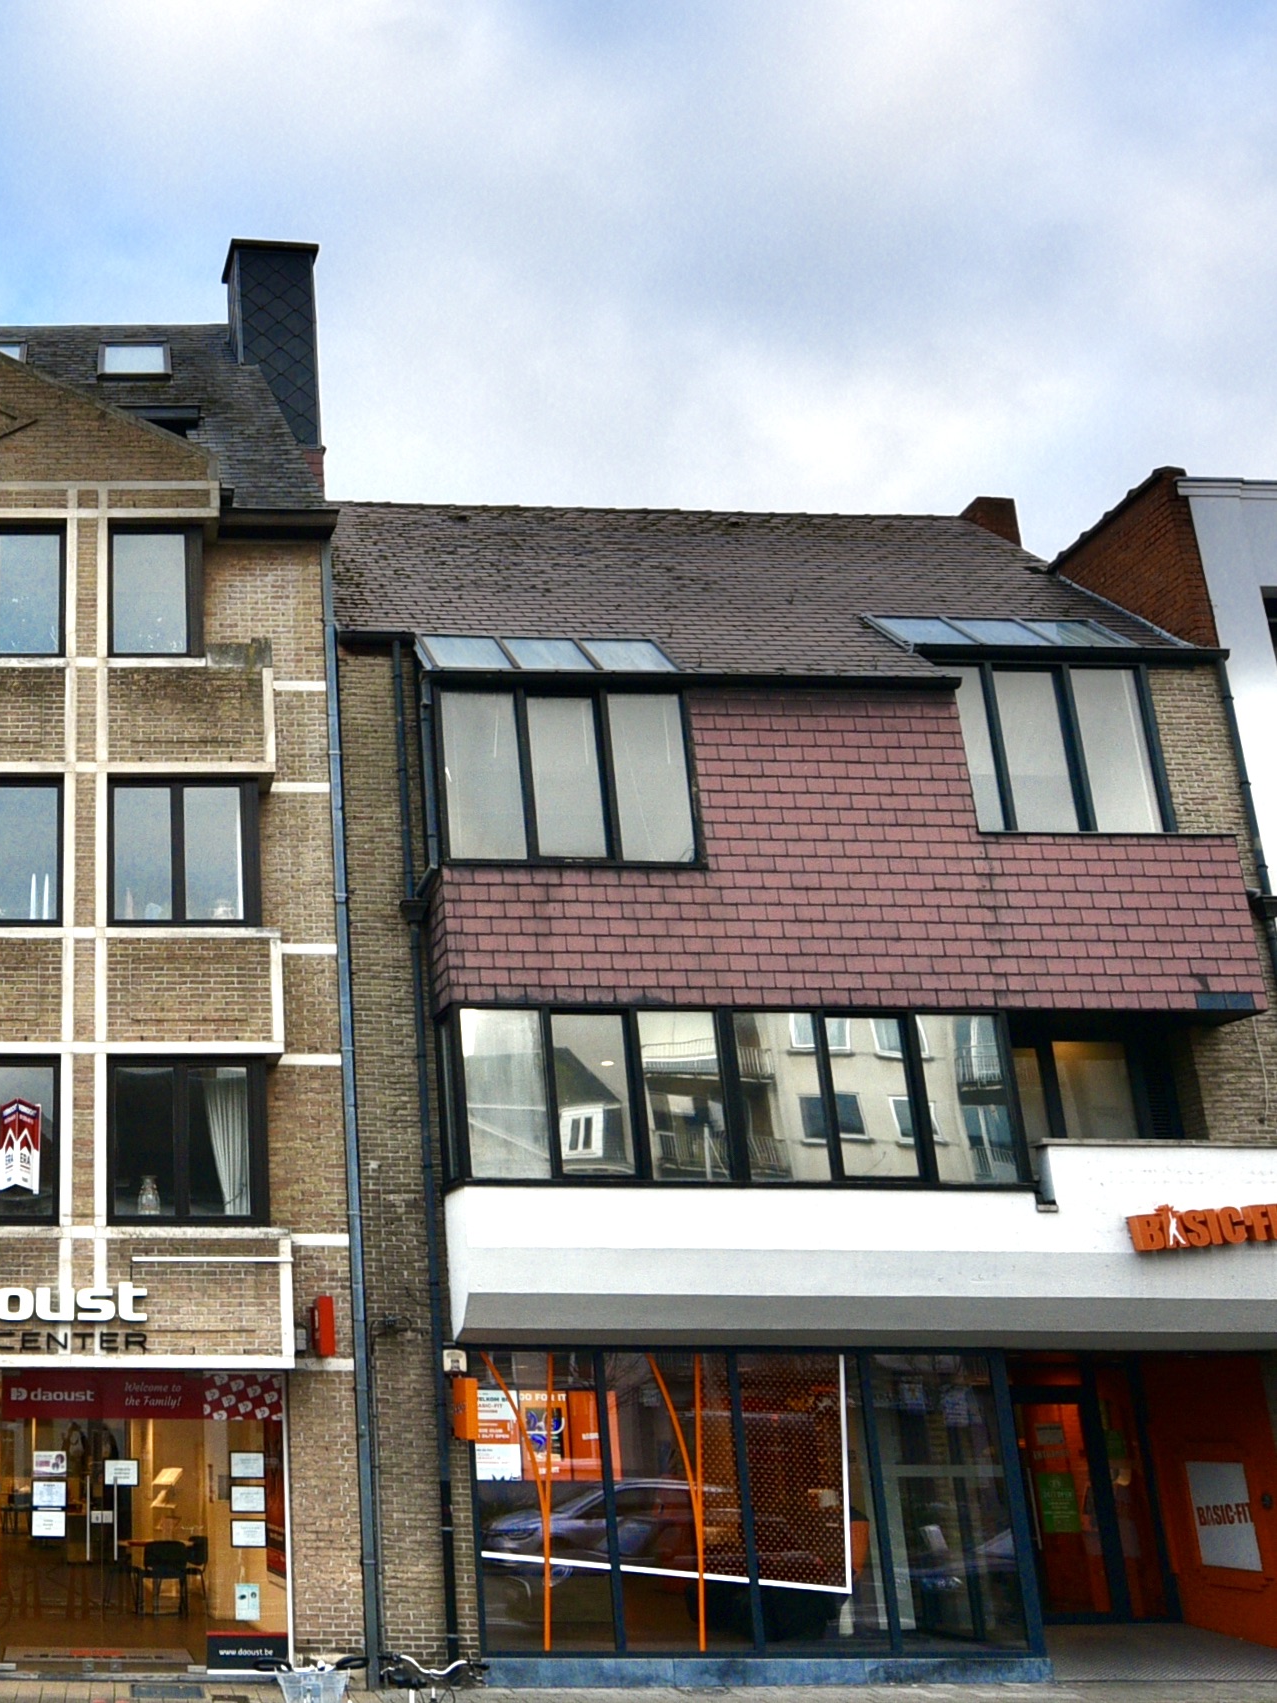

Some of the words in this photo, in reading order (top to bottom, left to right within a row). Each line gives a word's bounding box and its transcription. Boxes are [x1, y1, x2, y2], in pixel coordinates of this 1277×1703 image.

[124, 1381, 169, 1393] Welcome
[172, 1384, 182, 1393] to
[30, 1388, 95, 1402] daoust
[124, 1395, 141, 1406] the
[143, 1395, 182, 1410] Family!
[218, 1647, 274, 1657] www.daoust.be
